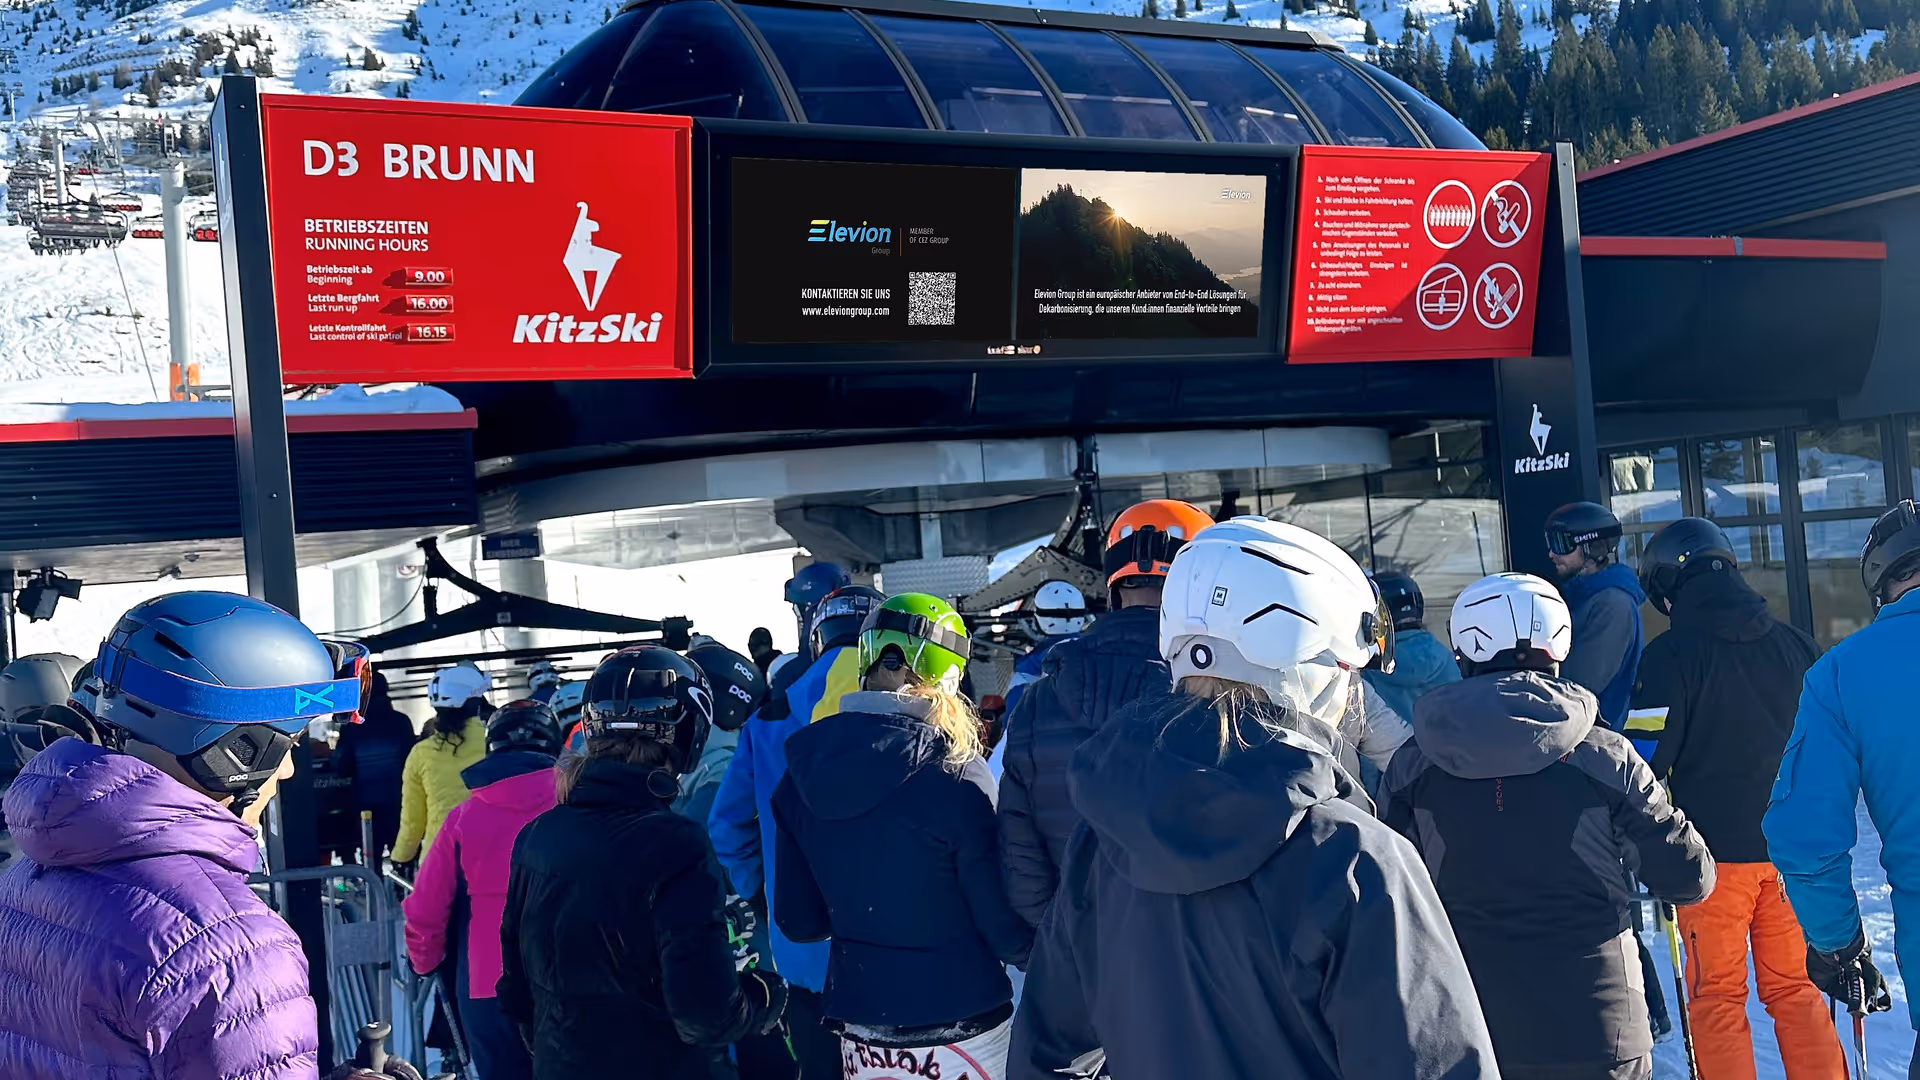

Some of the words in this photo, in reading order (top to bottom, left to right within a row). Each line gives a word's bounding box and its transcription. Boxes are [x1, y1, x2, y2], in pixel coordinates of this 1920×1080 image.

[303, 140, 359, 177] D3
[384, 143, 535, 183] BRUNN
[304, 219, 429, 234] BETRIEBSZEITEN
[808, 220, 891, 243] Elevion
[305, 237, 375, 251] RUNNING
[379, 238, 429, 252] HOURS
[306, 265, 360, 274] Betriebszeit
[361, 265, 373, 274] ab
[307, 275, 353, 286] Beginning
[414, 271, 445, 283] 9.00
[801, 288, 859, 299] KONTAKTIEREN
[860, 288, 873, 299] SIE
[875, 288, 890, 299] UNS
[1034, 289, 1056, 299] Elevion
[1057, 289, 1076, 301] Group
[1076, 289, 1085, 299] ist
[1086, 289, 1095, 299] ein
[1096, 289, 1135, 301] europäischer
[1136, 289, 1161, 299] Anbieter
[1163, 291, 1173, 299] von
[1174, 289, 1208, 299] End-to-End
[1209, 289, 1236, 301] Lösungen
[308, 294, 335, 303] Letzte
[337, 294, 380, 305] Bergfahrt
[411, 298, 448, 309] 16.00
[308, 304, 327, 312] Last
[328, 304, 344, 312] run
[346, 304, 358, 314] up
[802, 305, 890, 318] www.eleviongroup.com
[1095, 303, 1105, 314] die
[1106, 305, 1130, 314] unseren
[1166, 303, 1195, 314] finanzielle
[1196, 303, 1217, 314] Vorteile
[1218, 304, 1241, 316] bringen
[309, 324, 334, 332] Letzte
[335, 324, 387, 332] Kontrollfahrt
[416, 327, 447, 338] 16.15
[512, 312, 663, 343] KitzSki
[379, 333, 402, 343] patrol
[1515, 452, 1570, 474] KitzSki
[1574, 532, 1598, 543] SMITH
